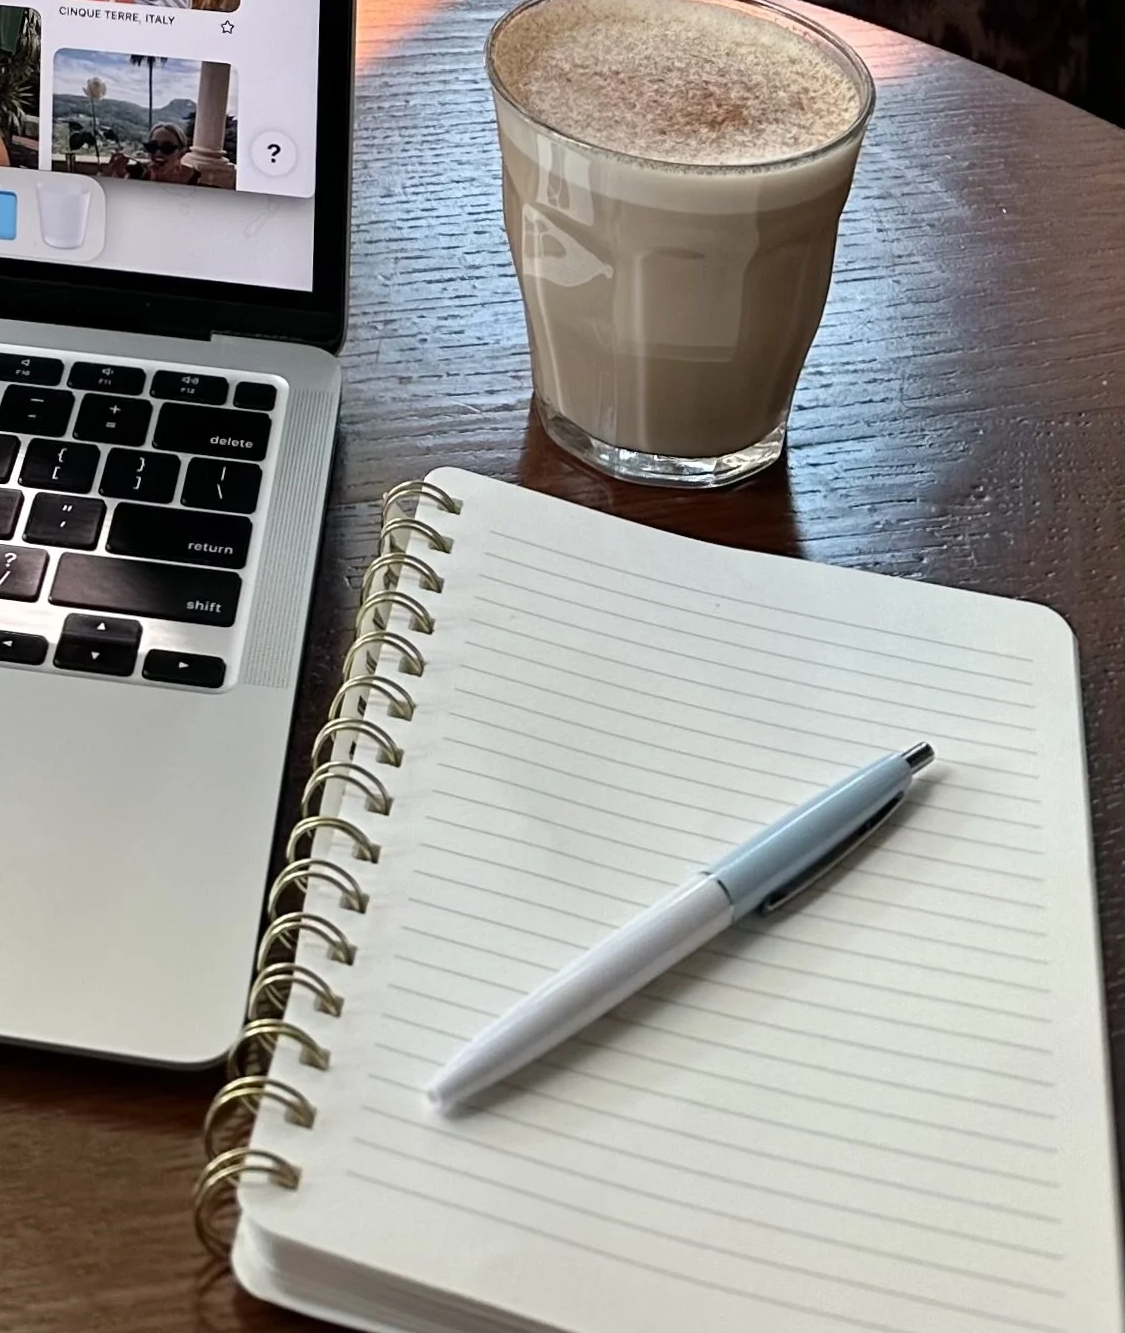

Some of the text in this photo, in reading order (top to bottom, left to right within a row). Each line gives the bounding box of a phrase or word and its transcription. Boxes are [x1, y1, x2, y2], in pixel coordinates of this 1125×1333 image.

[59, 6, 175, 25] CINQUE TERRE, ITALY
[267, 143, 281, 163] ?
[210, 436, 253, 448] delete
[187, 542, 234, 555] return
[186, 600, 222, 613] shift
